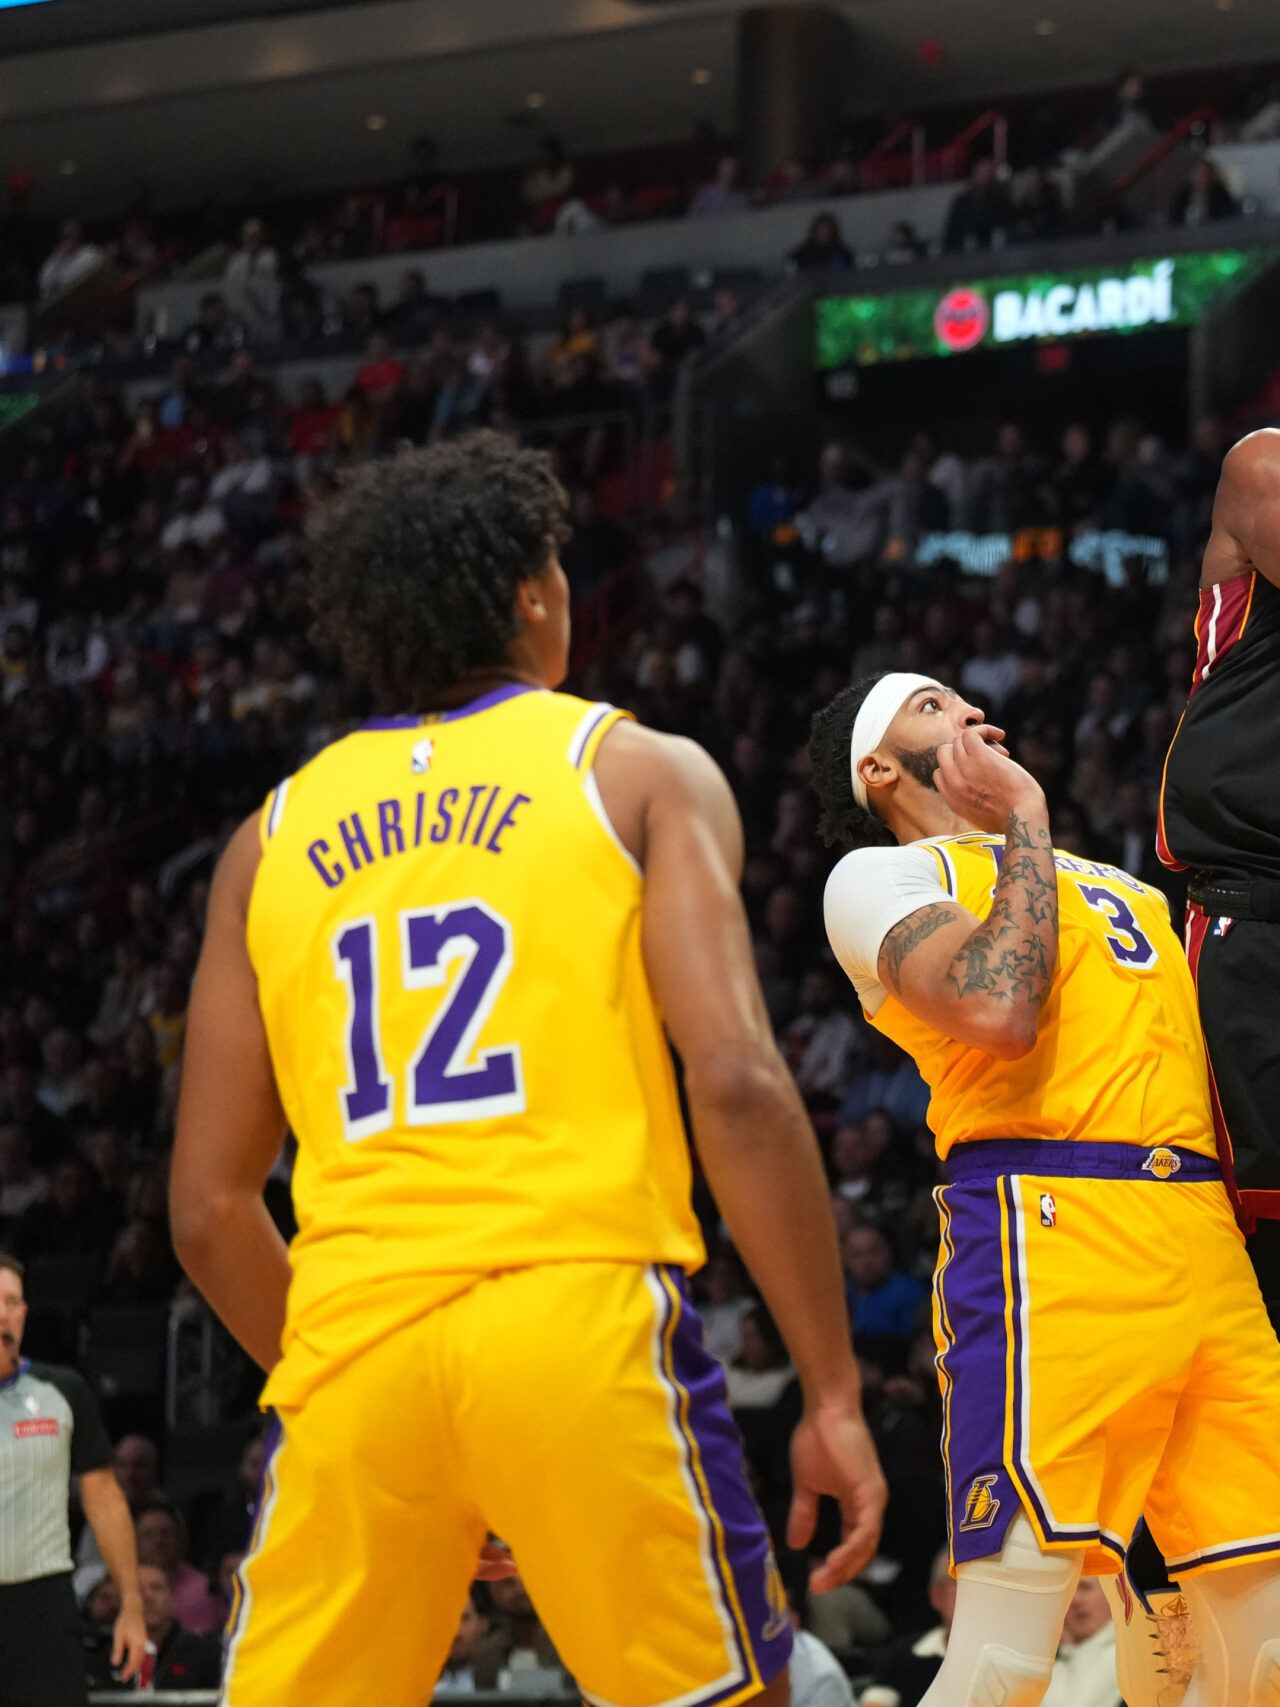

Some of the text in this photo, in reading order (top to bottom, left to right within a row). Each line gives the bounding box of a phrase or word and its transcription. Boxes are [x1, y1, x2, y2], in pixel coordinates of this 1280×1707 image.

[307, 785, 531, 889] CHRISTIE
[1077, 882, 1159, 970] 3
[331, 897, 527, 1143] 12
[1146, 1153, 1181, 1172] LAKERS
